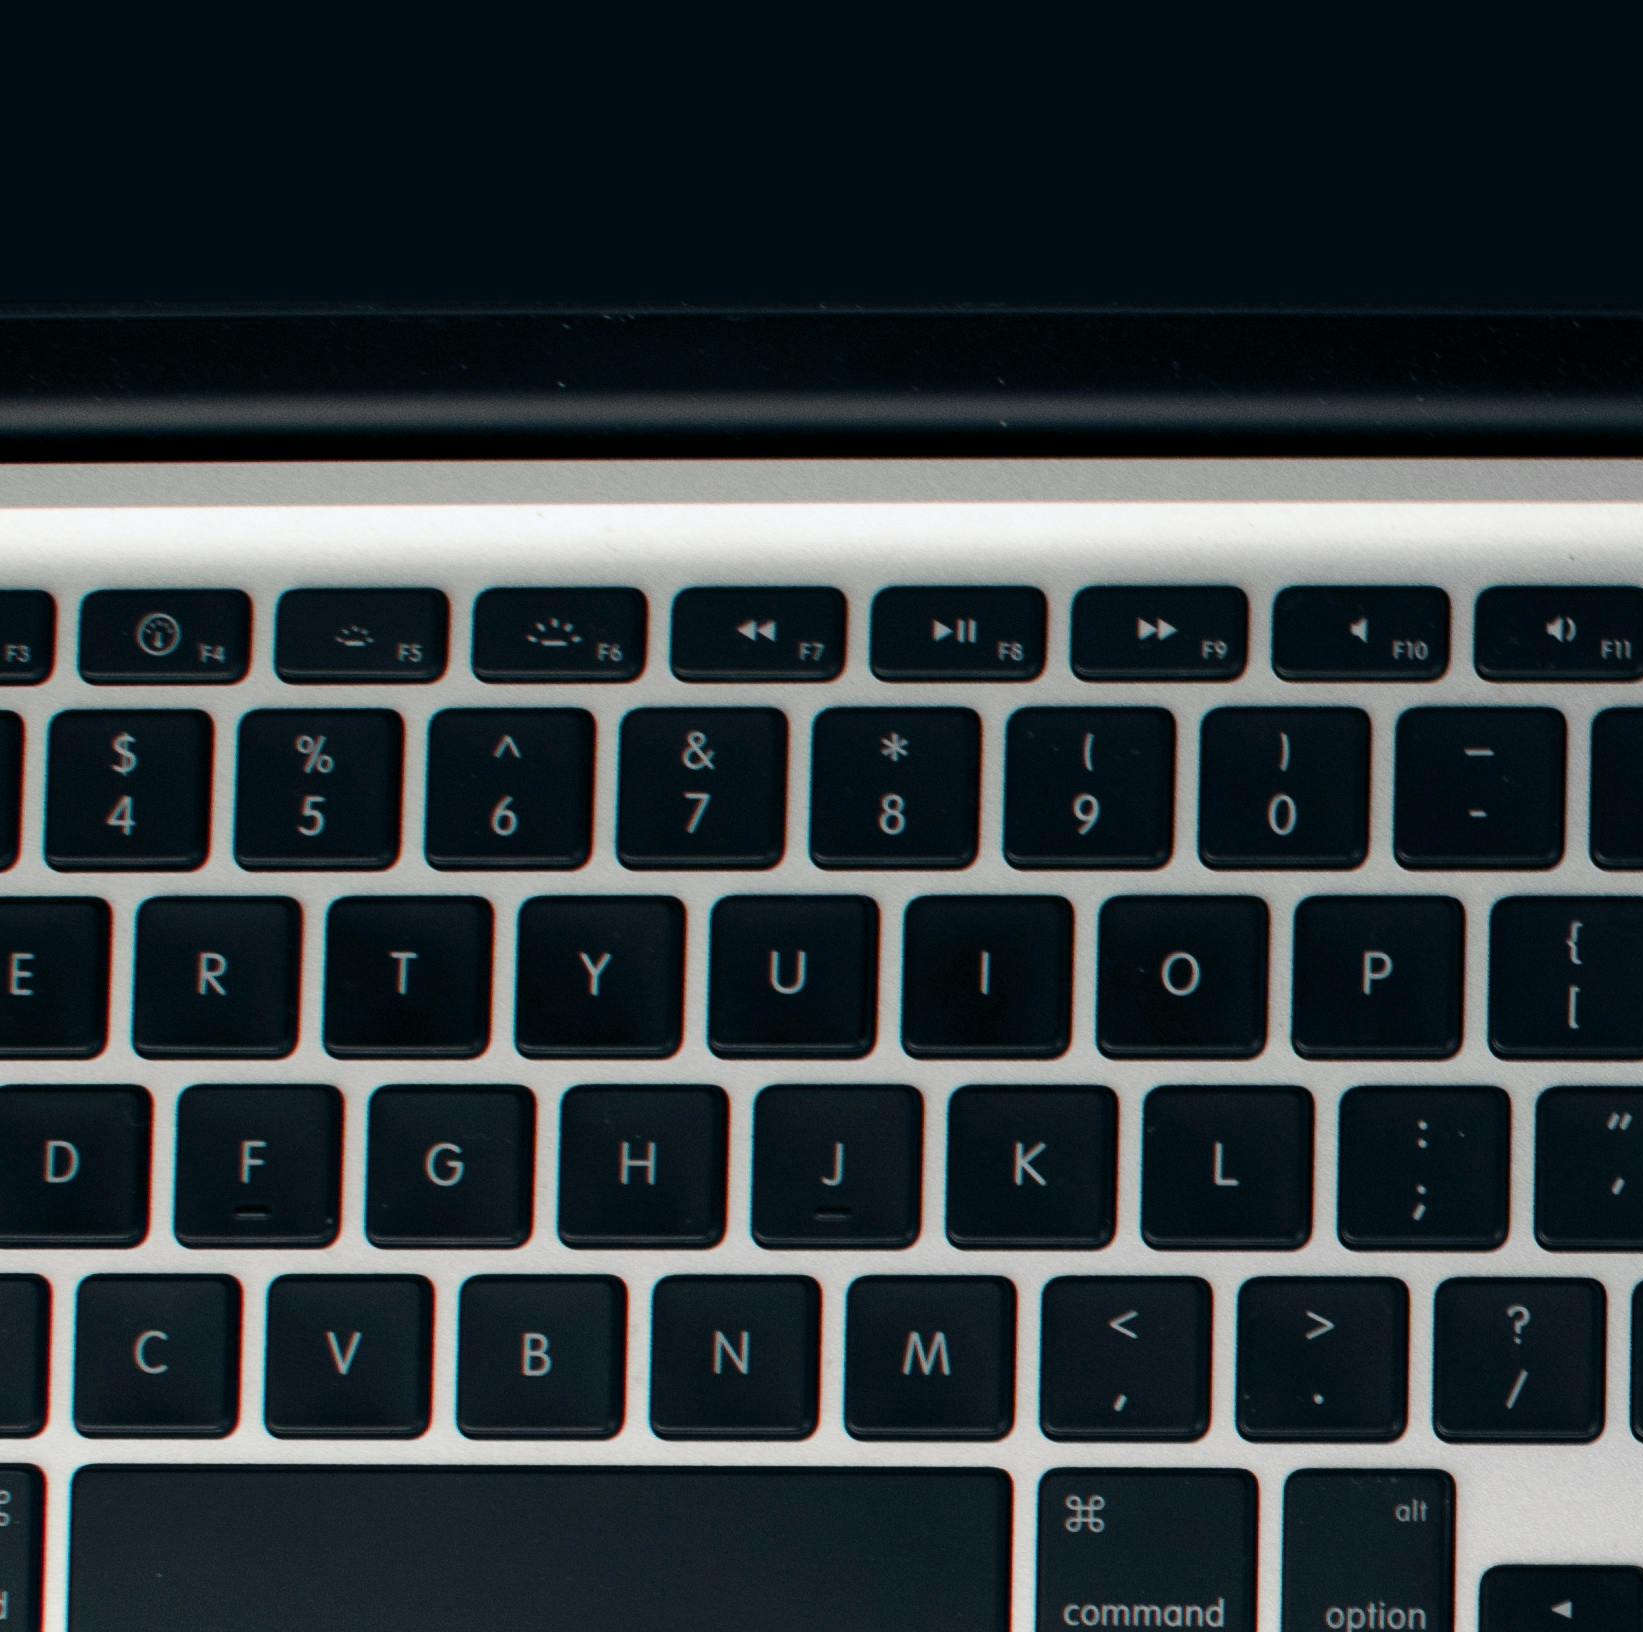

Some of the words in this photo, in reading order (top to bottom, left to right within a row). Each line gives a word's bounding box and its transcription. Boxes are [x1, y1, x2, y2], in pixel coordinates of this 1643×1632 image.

[6, 644, 31, 663] F3
[200, 645, 226, 662] F4
[398, 643, 422, 663] F5
[597, 643, 623, 662] F6
[799, 642, 825, 661] F7
[998, 642, 1024, 661] F8
[1202, 640, 1228, 659] F9
[1392, 640, 1429, 660] F10
[1601, 640, 1632, 659] F11
[112, 733, 137, 776] $
[295, 735, 335, 774] %
[682, 731, 715, 771] &
[106, 795, 137, 836] 4
[298, 795, 326, 837] 5
[491, 796, 519, 837] 6
[684, 792, 711, 834] 7
[879, 794, 906, 836] 8
[1073, 793, 1100, 835] 9
[1267, 794, 1298, 836] 0
[1566, 921, 1583, 965] {
[9, 952, 35, 996] E
[197, 952, 228, 996] R
[389, 951, 418, 995] T
[579, 952, 612, 996] Y
[769, 950, 807, 995] U
[1160, 951, 1201, 997] O
[1362, 951, 1393, 995] P
[44, 1140, 80, 1184] D
[240, 1140, 267, 1184] F
[425, 1142, 465, 1187] G
[620, 1141, 657, 1185] H
[821, 1142, 845, 1187] J
[1013, 1142, 1047, 1186] K
[1213, 1142, 1239, 1187] L
[1109, 1311, 1138, 1339] <
[1306, 1311, 1335, 1340] >
[1507, 1305, 1531, 1345] ?
[133, 1330, 169, 1374] C
[326, 1331, 362, 1375] V
[521, 1332, 552, 1377] B
[713, 1330, 750, 1375] N
[902, 1331, 951, 1376] M
[1506, 1370, 1529, 1409] /
[1395, 1499, 1428, 1522] alt
[1063, 1597, 1225, 1628] command
